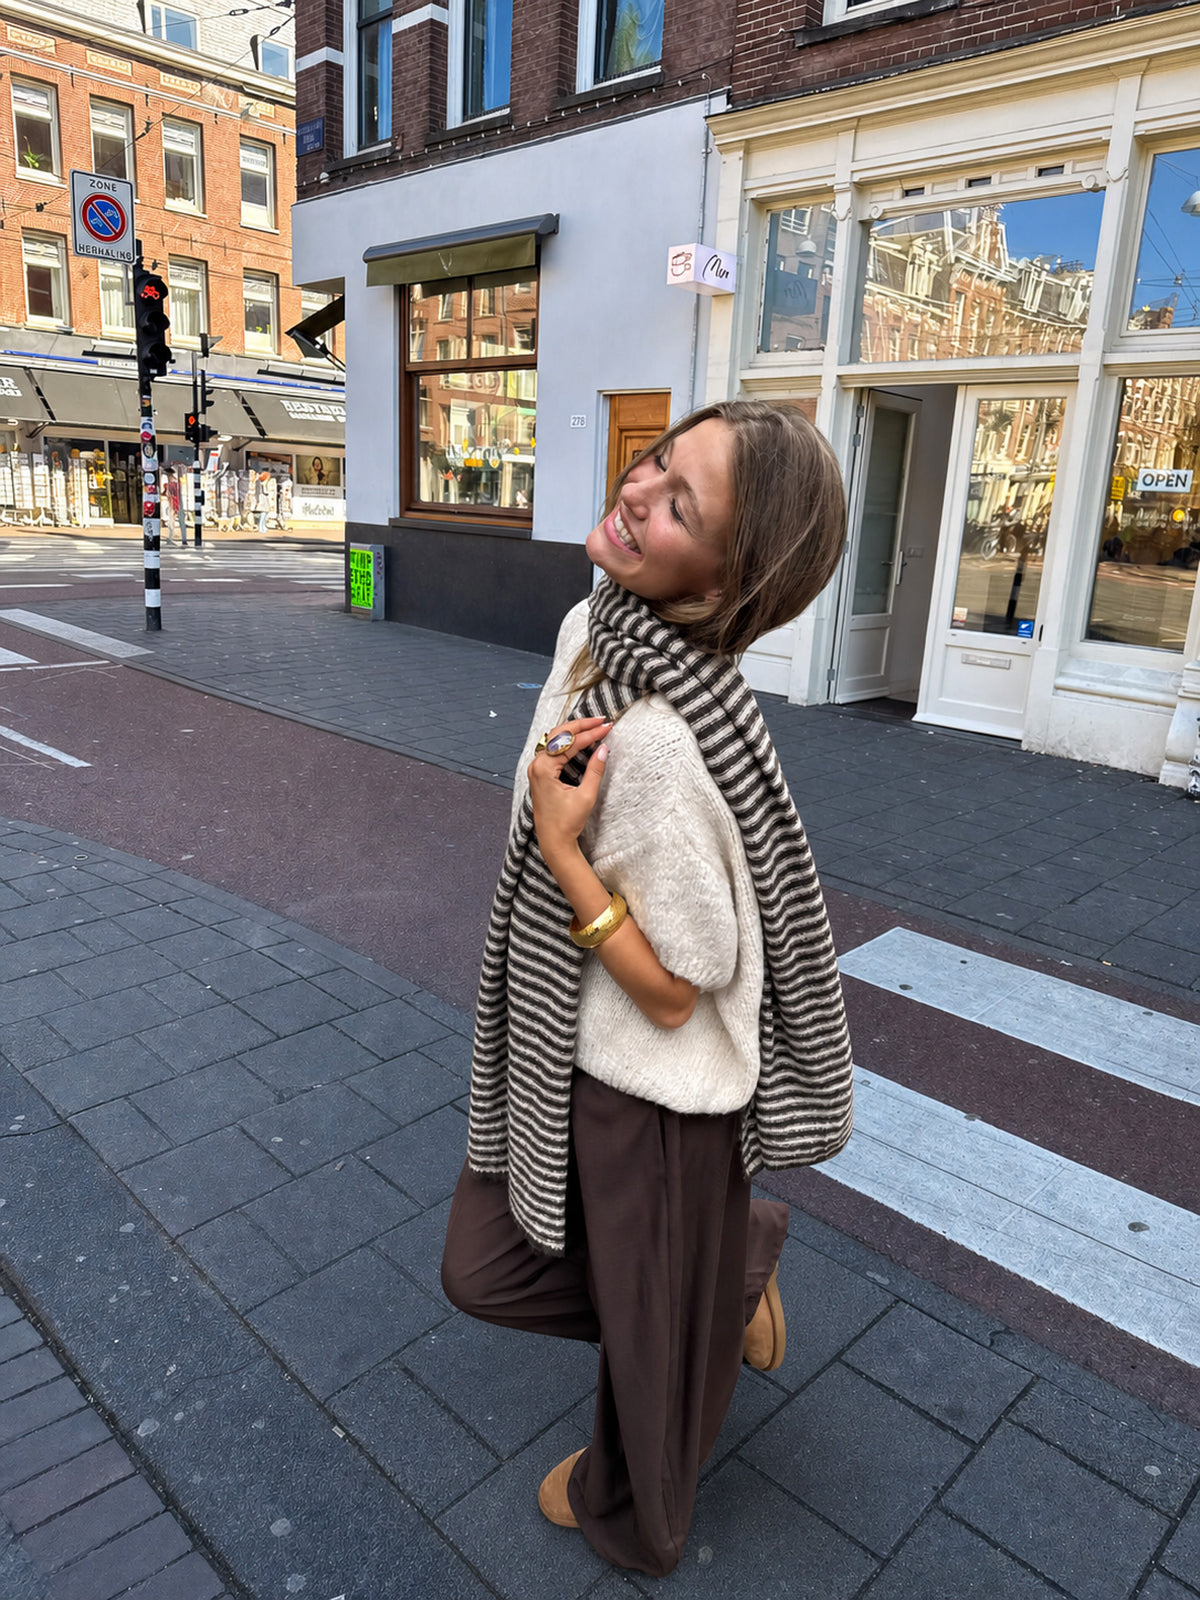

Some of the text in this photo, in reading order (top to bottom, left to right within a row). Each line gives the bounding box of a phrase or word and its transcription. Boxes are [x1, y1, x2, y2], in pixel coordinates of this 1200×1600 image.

[89, 179, 117, 191] ZONE
[79, 244, 132, 260] HERHALING
[1142, 473, 1188, 487] OPEN
